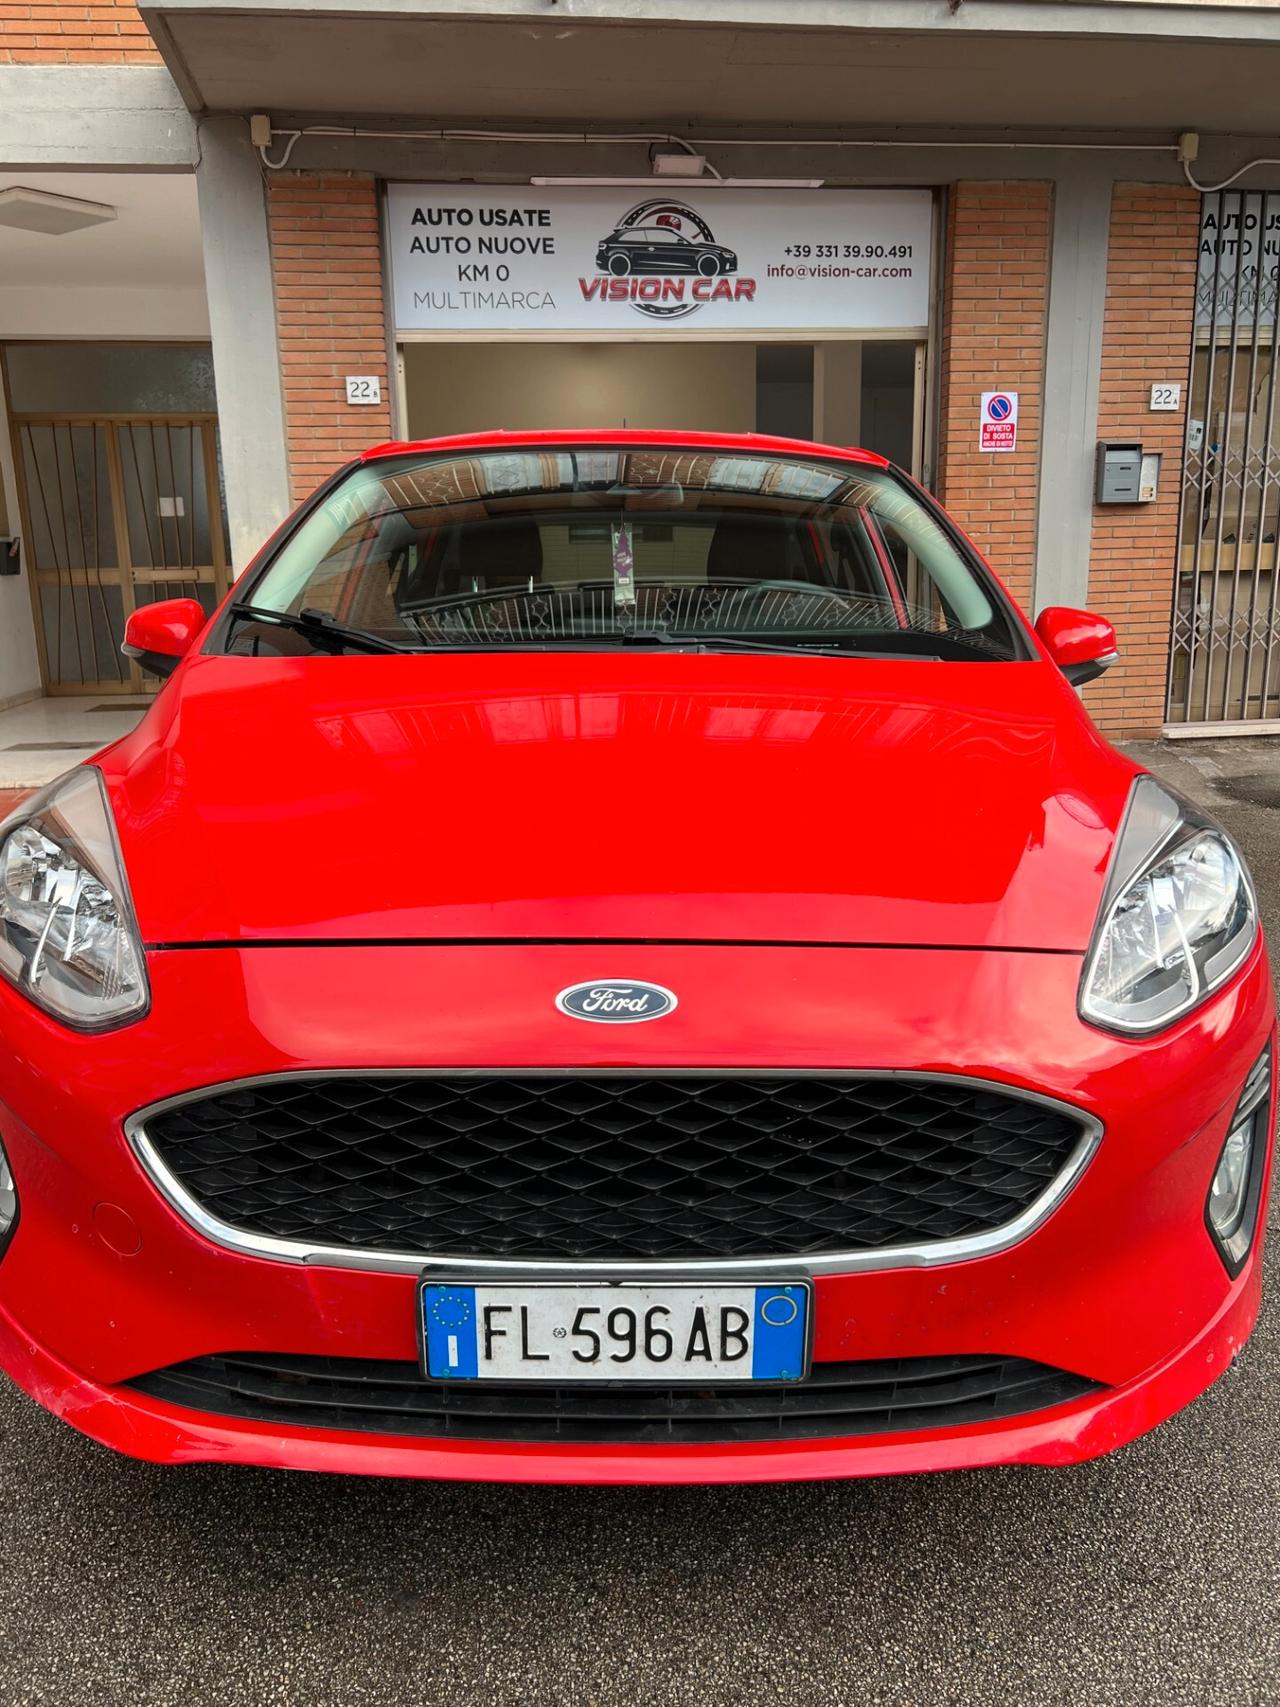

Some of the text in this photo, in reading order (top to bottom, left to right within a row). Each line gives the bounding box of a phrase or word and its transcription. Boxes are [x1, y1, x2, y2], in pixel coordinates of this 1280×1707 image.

[411, 208, 551, 227] AUTO USATE
[410, 236, 555, 254] AUTO NUOVE
[784, 245, 913, 258] +39 331 39.90.491
[458, 264, 489, 281] KM
[767, 264, 913, 280] info@vision-car.com
[578, 277, 757, 302] VISION CAR
[413, 291, 556, 309] MULTIMARCA
[983, 432, 1013, 440] DI SOSTA
[582, 988, 649, 1012] Ford
